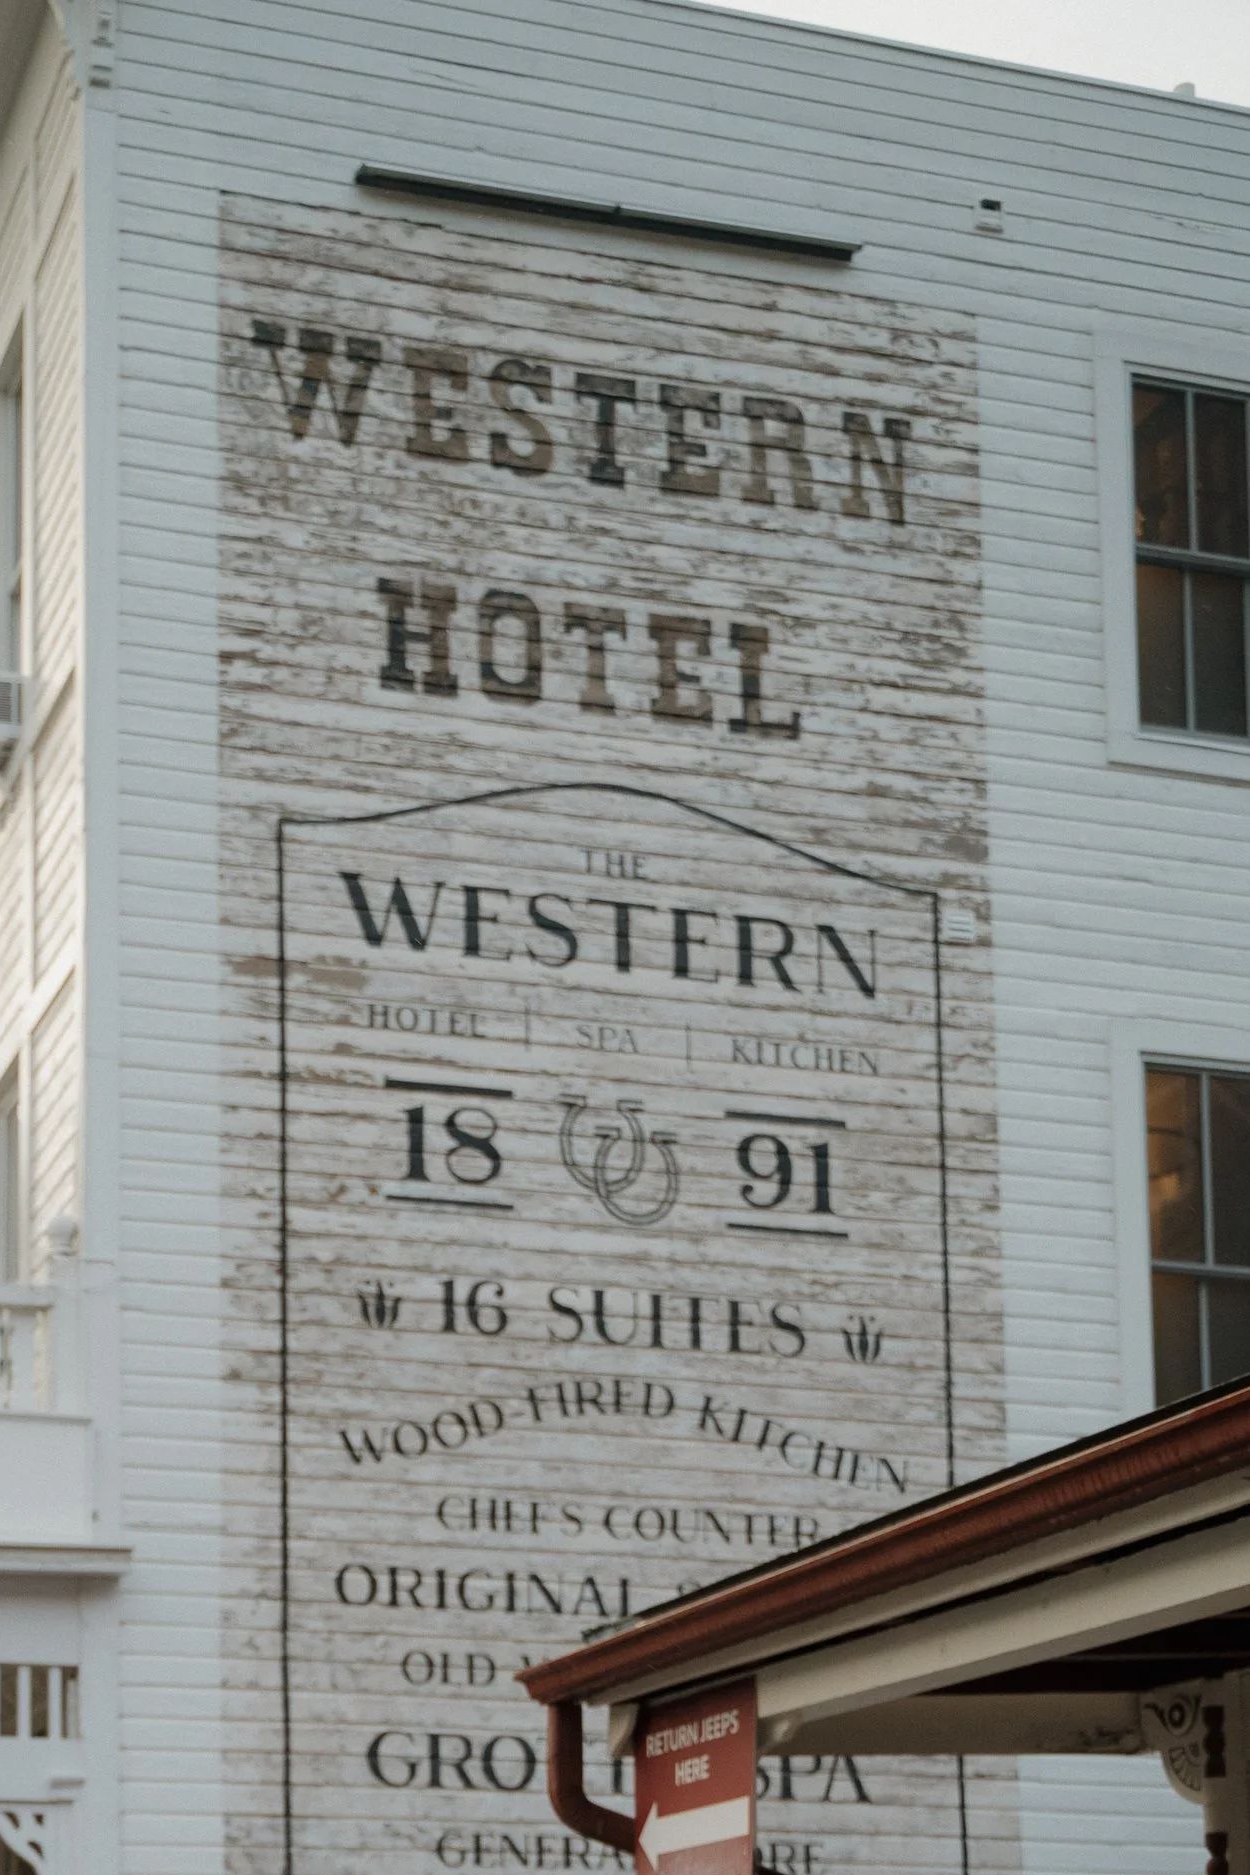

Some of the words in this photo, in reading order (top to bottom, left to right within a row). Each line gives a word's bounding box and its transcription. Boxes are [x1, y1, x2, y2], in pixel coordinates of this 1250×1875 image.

[251, 319, 913, 527] WESTERN
[377, 576, 802, 741] HOTEL
[581, 847, 648, 879] THE
[338, 870, 878, 998] WESTERN
[367, 1003, 487, 1039] HOTEL
[576, 1023, 640, 1055] SPA
[731, 1037, 879, 1076] KITCHEN
[403, 1106, 502, 1185] 18
[737, 1133, 836, 1215] 91
[440, 1279, 508, 1337] 16
[549, 1285, 806, 1359] SUITES
[338, 1379, 675, 1467] WOOD-FIRED
[697, 1395, 910, 1495] KITCHEN
[603, 1507, 821, 1549] COUNTER
[335, 1562, 638, 1619] ORIGINAL
[401, 1649, 497, 1687] OLD
[647, 1723, 699, 1757] RETURN
[701, 1709, 739, 1743] JEEPS
[676, 1754, 710, 1786] HERE
[435, 1829, 635, 1873] GENERA
